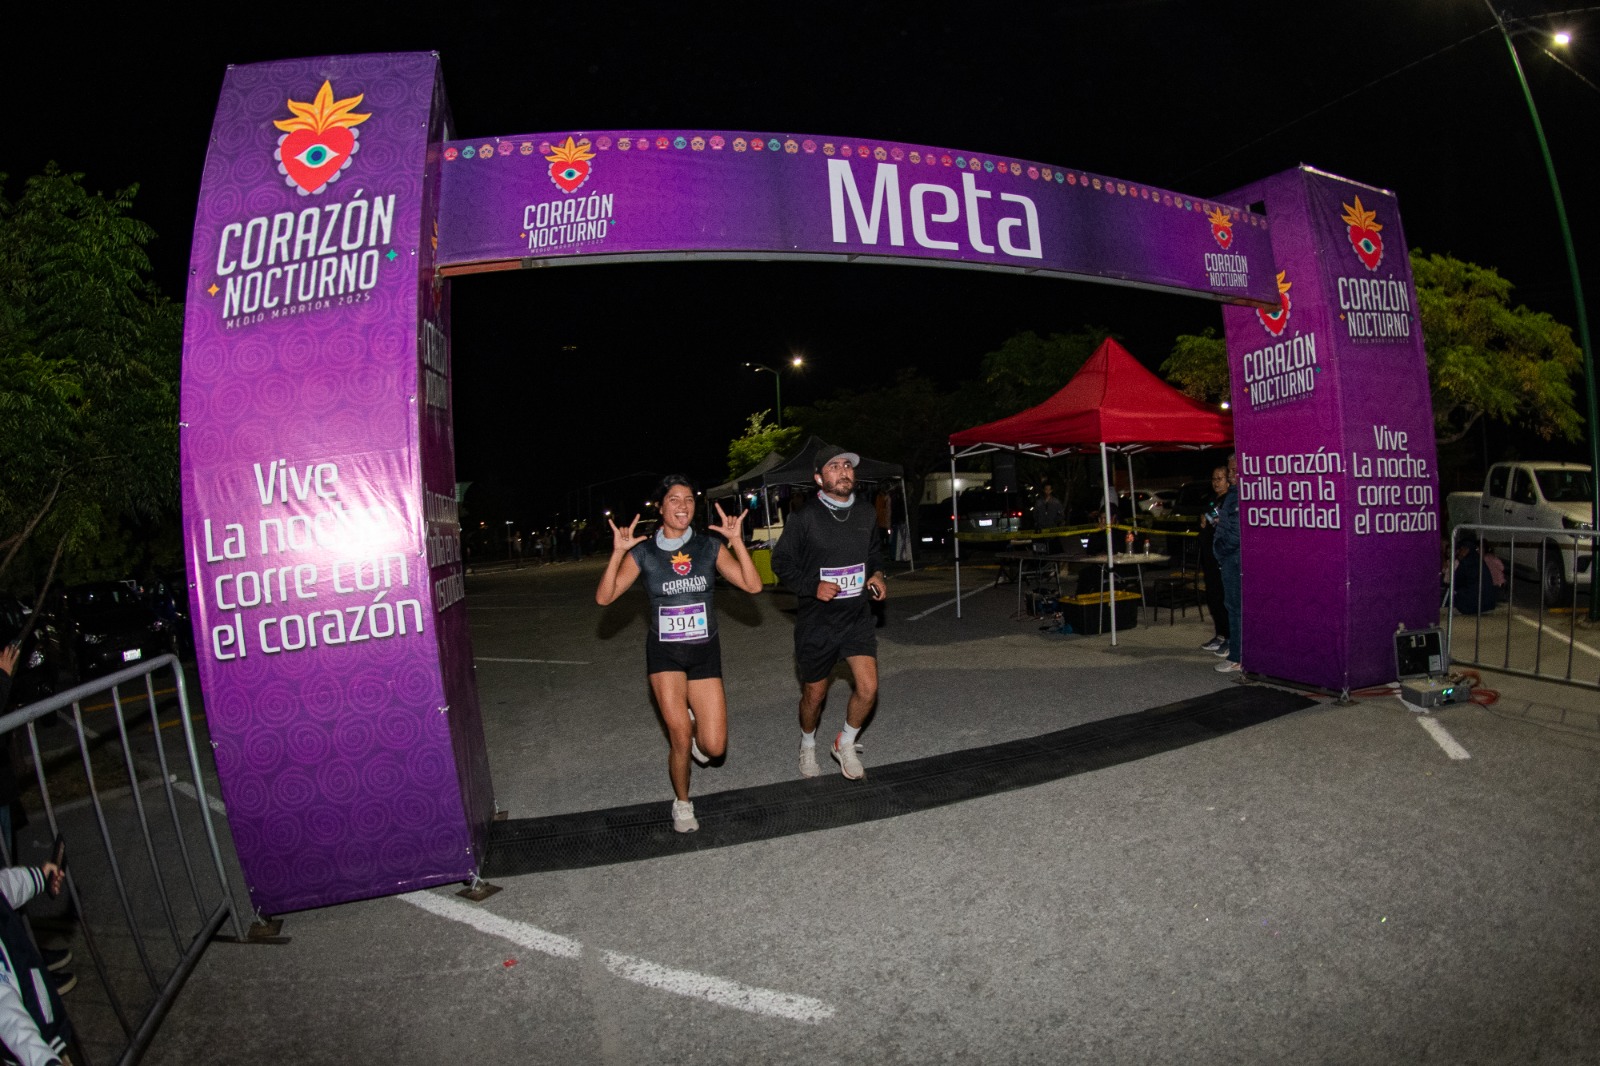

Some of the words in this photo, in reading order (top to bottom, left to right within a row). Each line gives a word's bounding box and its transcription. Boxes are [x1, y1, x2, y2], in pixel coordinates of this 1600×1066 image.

[523, 190, 614, 230] CORAZÓN
[827, 158, 1043, 259] Meta
[216, 188, 396, 276] CORAZÓN
[528, 219, 607, 249] NOCTURNO
[1204, 251, 1249, 273] CORAZÓN
[222, 250, 379, 319] NOCTURNO
[1209, 272, 1248, 288] NOCTURNO
[1338, 273, 1410, 312] CORAZÓN
[226, 312, 265, 330] MEDIO
[338, 291, 371, 306] 2025
[1347, 311, 1410, 337] NOCTURNO
[1243, 330, 1317, 383] CORAZÓN
[1250, 366, 1315, 406] NOCTURNO
[1373, 425, 1408, 451] Vive
[1241, 452, 1260, 475] tu
[1352, 452, 1372, 478] La
[253, 458, 339, 506] Vive
[1240, 476, 1283, 501] brilla
[1288, 481, 1312, 501] en
[1318, 475, 1336, 502] la
[1357, 484, 1401, 506] corre
[1405, 485, 1434, 505] con
[1247, 503, 1341, 529] oscuridad
[1354, 508, 1371, 535] el
[1375, 506, 1438, 534] corazón
[203, 518, 247, 563] La
[214, 562, 318, 611] corre
[331, 550, 409, 594] con
[662, 575, 707, 592] CORAZÓN
[211, 612, 247, 661] el
[258, 590, 424, 655] corazón
[667, 615, 696, 632] 394
